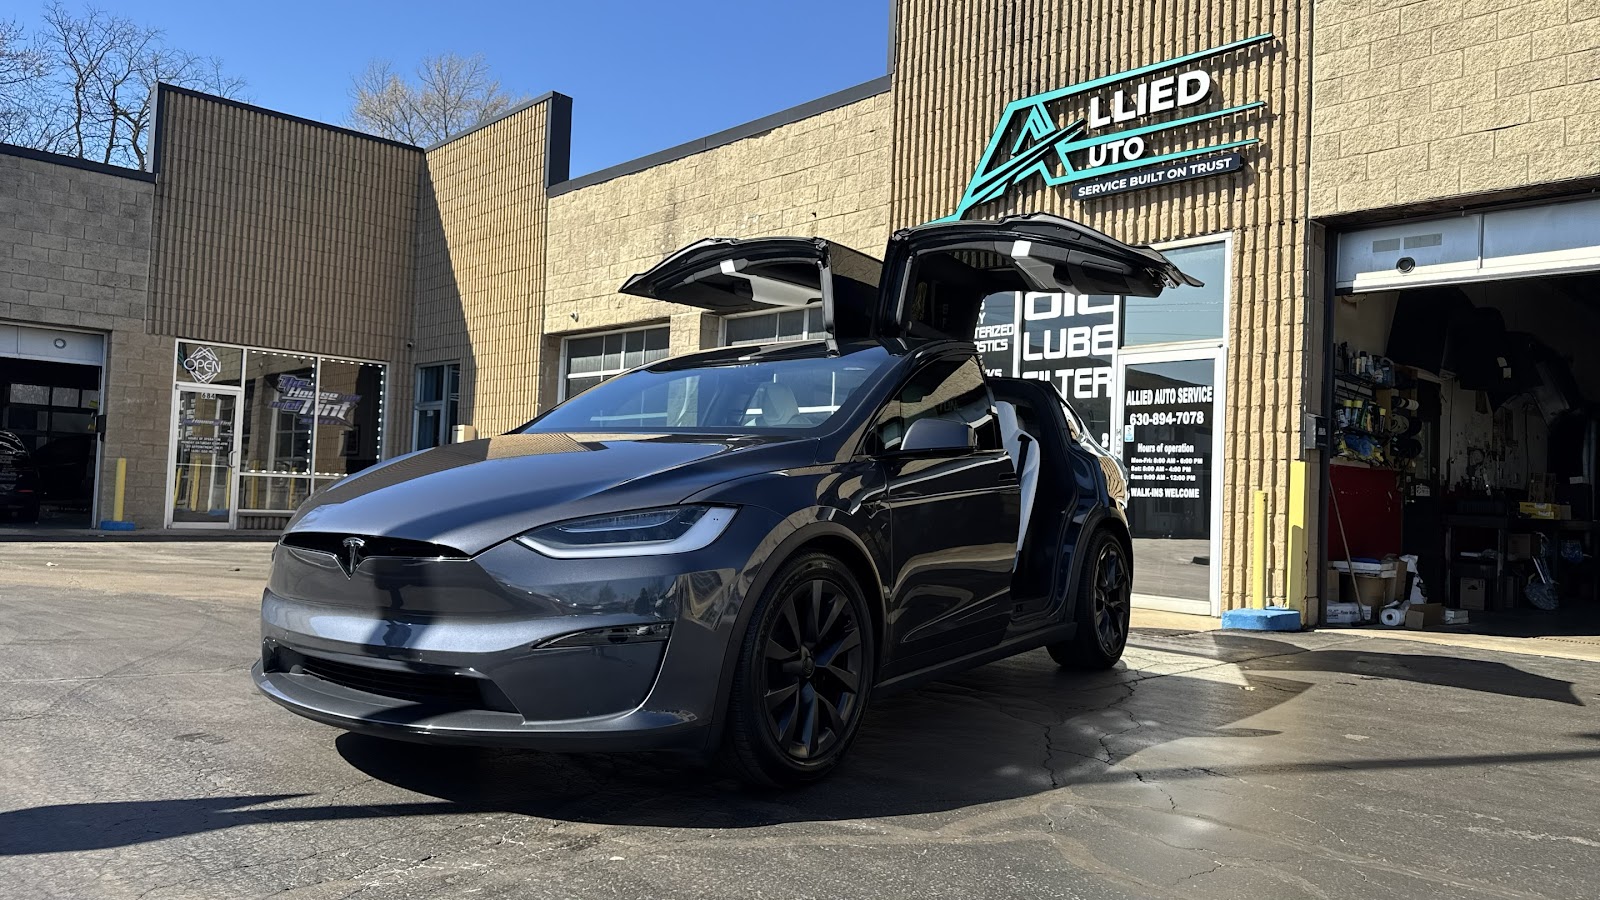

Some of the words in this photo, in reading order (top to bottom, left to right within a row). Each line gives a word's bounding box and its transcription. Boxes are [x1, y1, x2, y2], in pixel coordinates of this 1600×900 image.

[1078, 179, 1127, 197] SERVICE
[1129, 171, 1165, 187] BUILT
[1166, 166, 1187, 180] ON
[1189, 157, 1233, 175] TRUST
[1024, 291, 1114, 321] OIL
[974, 324, 1014, 340] TERIZED
[1023, 323, 1114, 362] LUBE
[183, 358, 222, 373] OPEN
[1022, 366, 1113, 400] TER
[1126, 389, 1153, 406] ALLIED
[1154, 388, 1177, 404] AUTO
[1177, 386, 1213, 404] SERVICE
[1129, 411, 1205, 426] 630-894-7078
[1137, 442, 1156, 453] Hours
[1156, 442, 1164, 453] of
[1164, 442, 1195, 455] operation
[1130, 487, 1164, 498] WALK-INS
[1164, 487, 1200, 498] WELCOME
